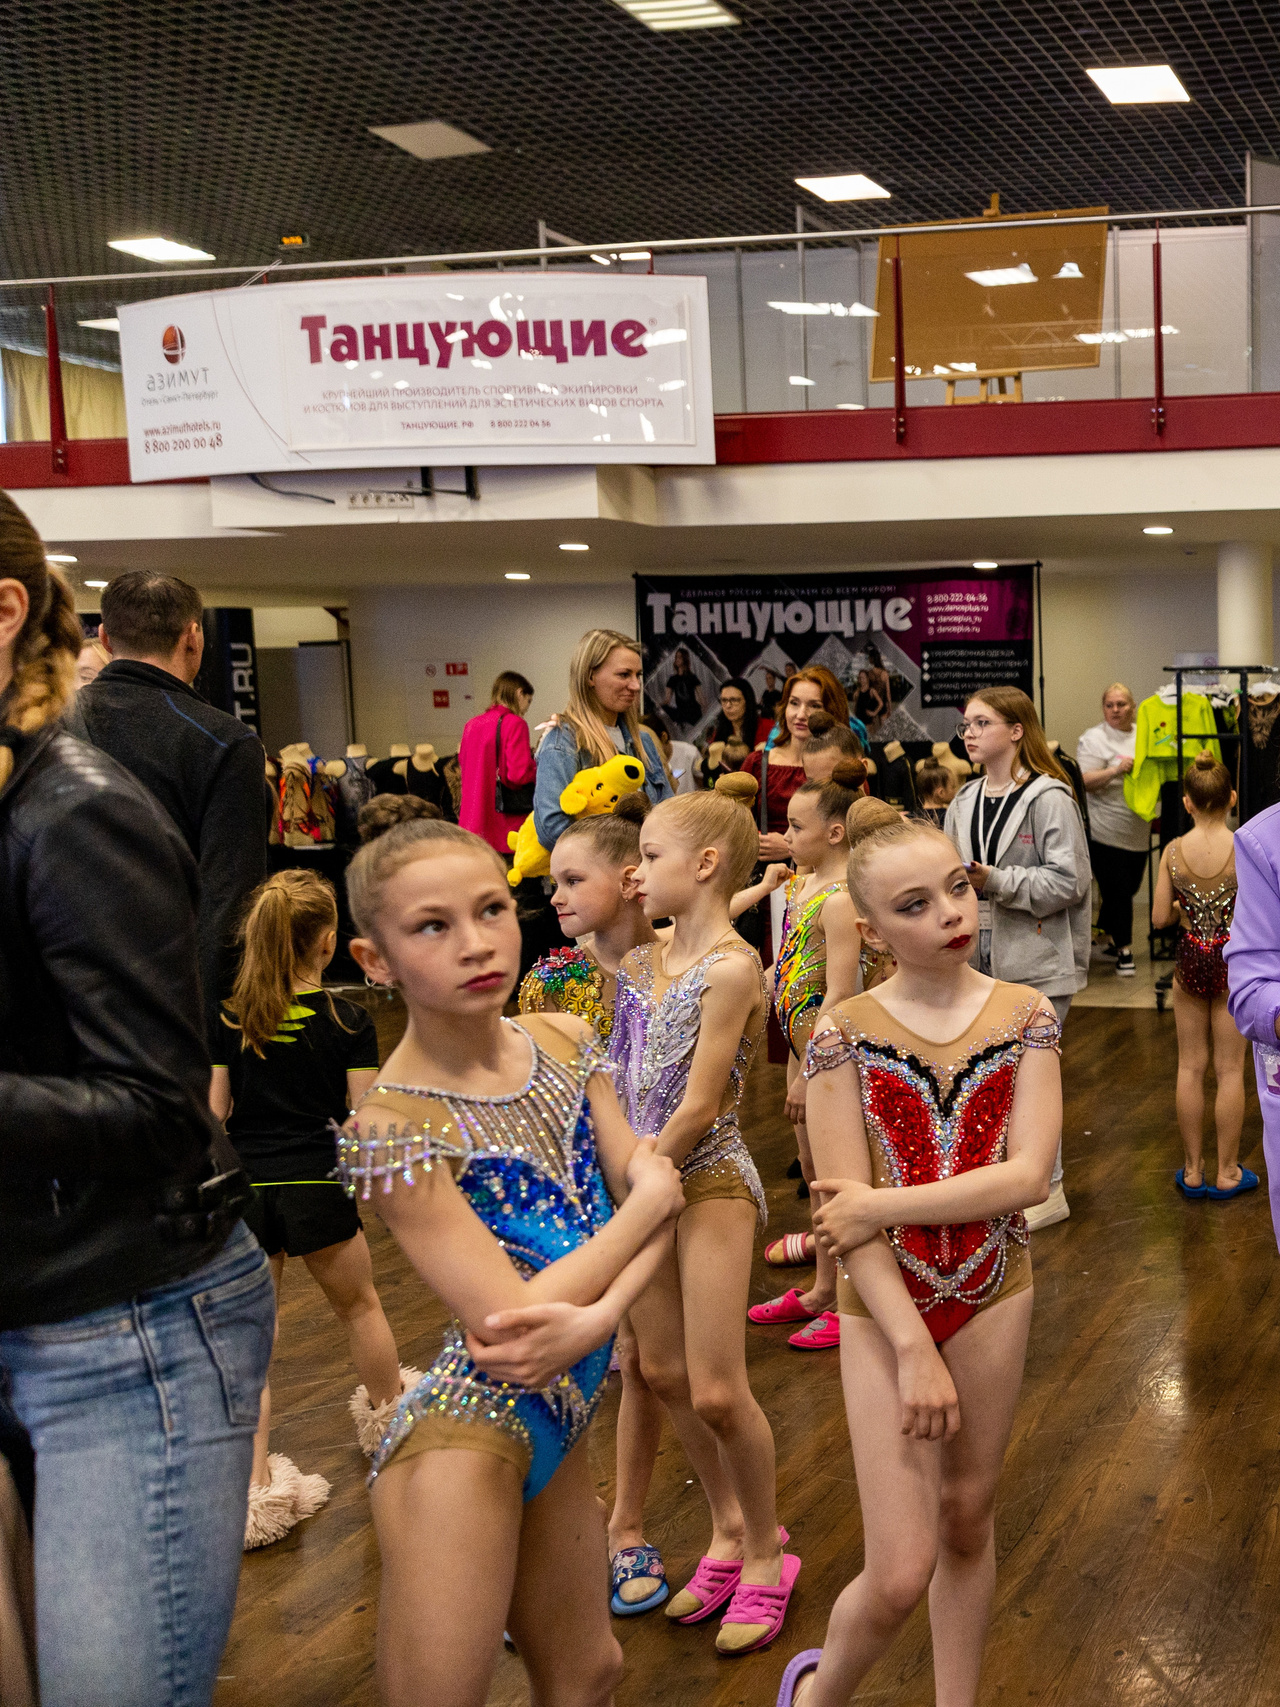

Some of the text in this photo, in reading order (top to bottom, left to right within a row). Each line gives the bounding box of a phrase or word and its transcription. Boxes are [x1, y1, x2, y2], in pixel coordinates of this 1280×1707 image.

[301, 314, 648, 369] Танцующие
[392, 385, 481, 397] ПРОИЗВОДИТЕЛЬ
[483, 383, 558, 395] СПОРТИВНЙ
[560, 384, 639, 395] ЭКИПИРОВКИ
[303, 405, 311, 414] И
[369, 400, 389, 412] ДЛЯ
[390, 397, 467, 411] ВЫСТУПЛЕНИЙ
[469, 398, 491, 410] ДЛЯ
[493, 397, 577, 409] ЭСТЕТИЧЕСКИХ
[578, 397, 618, 408] ВИДОВ
[619, 397, 665, 408] СПОРТА
[144, 432, 223, 454] 8 800 200 00 48
[646, 592, 913, 642] Танцующие
